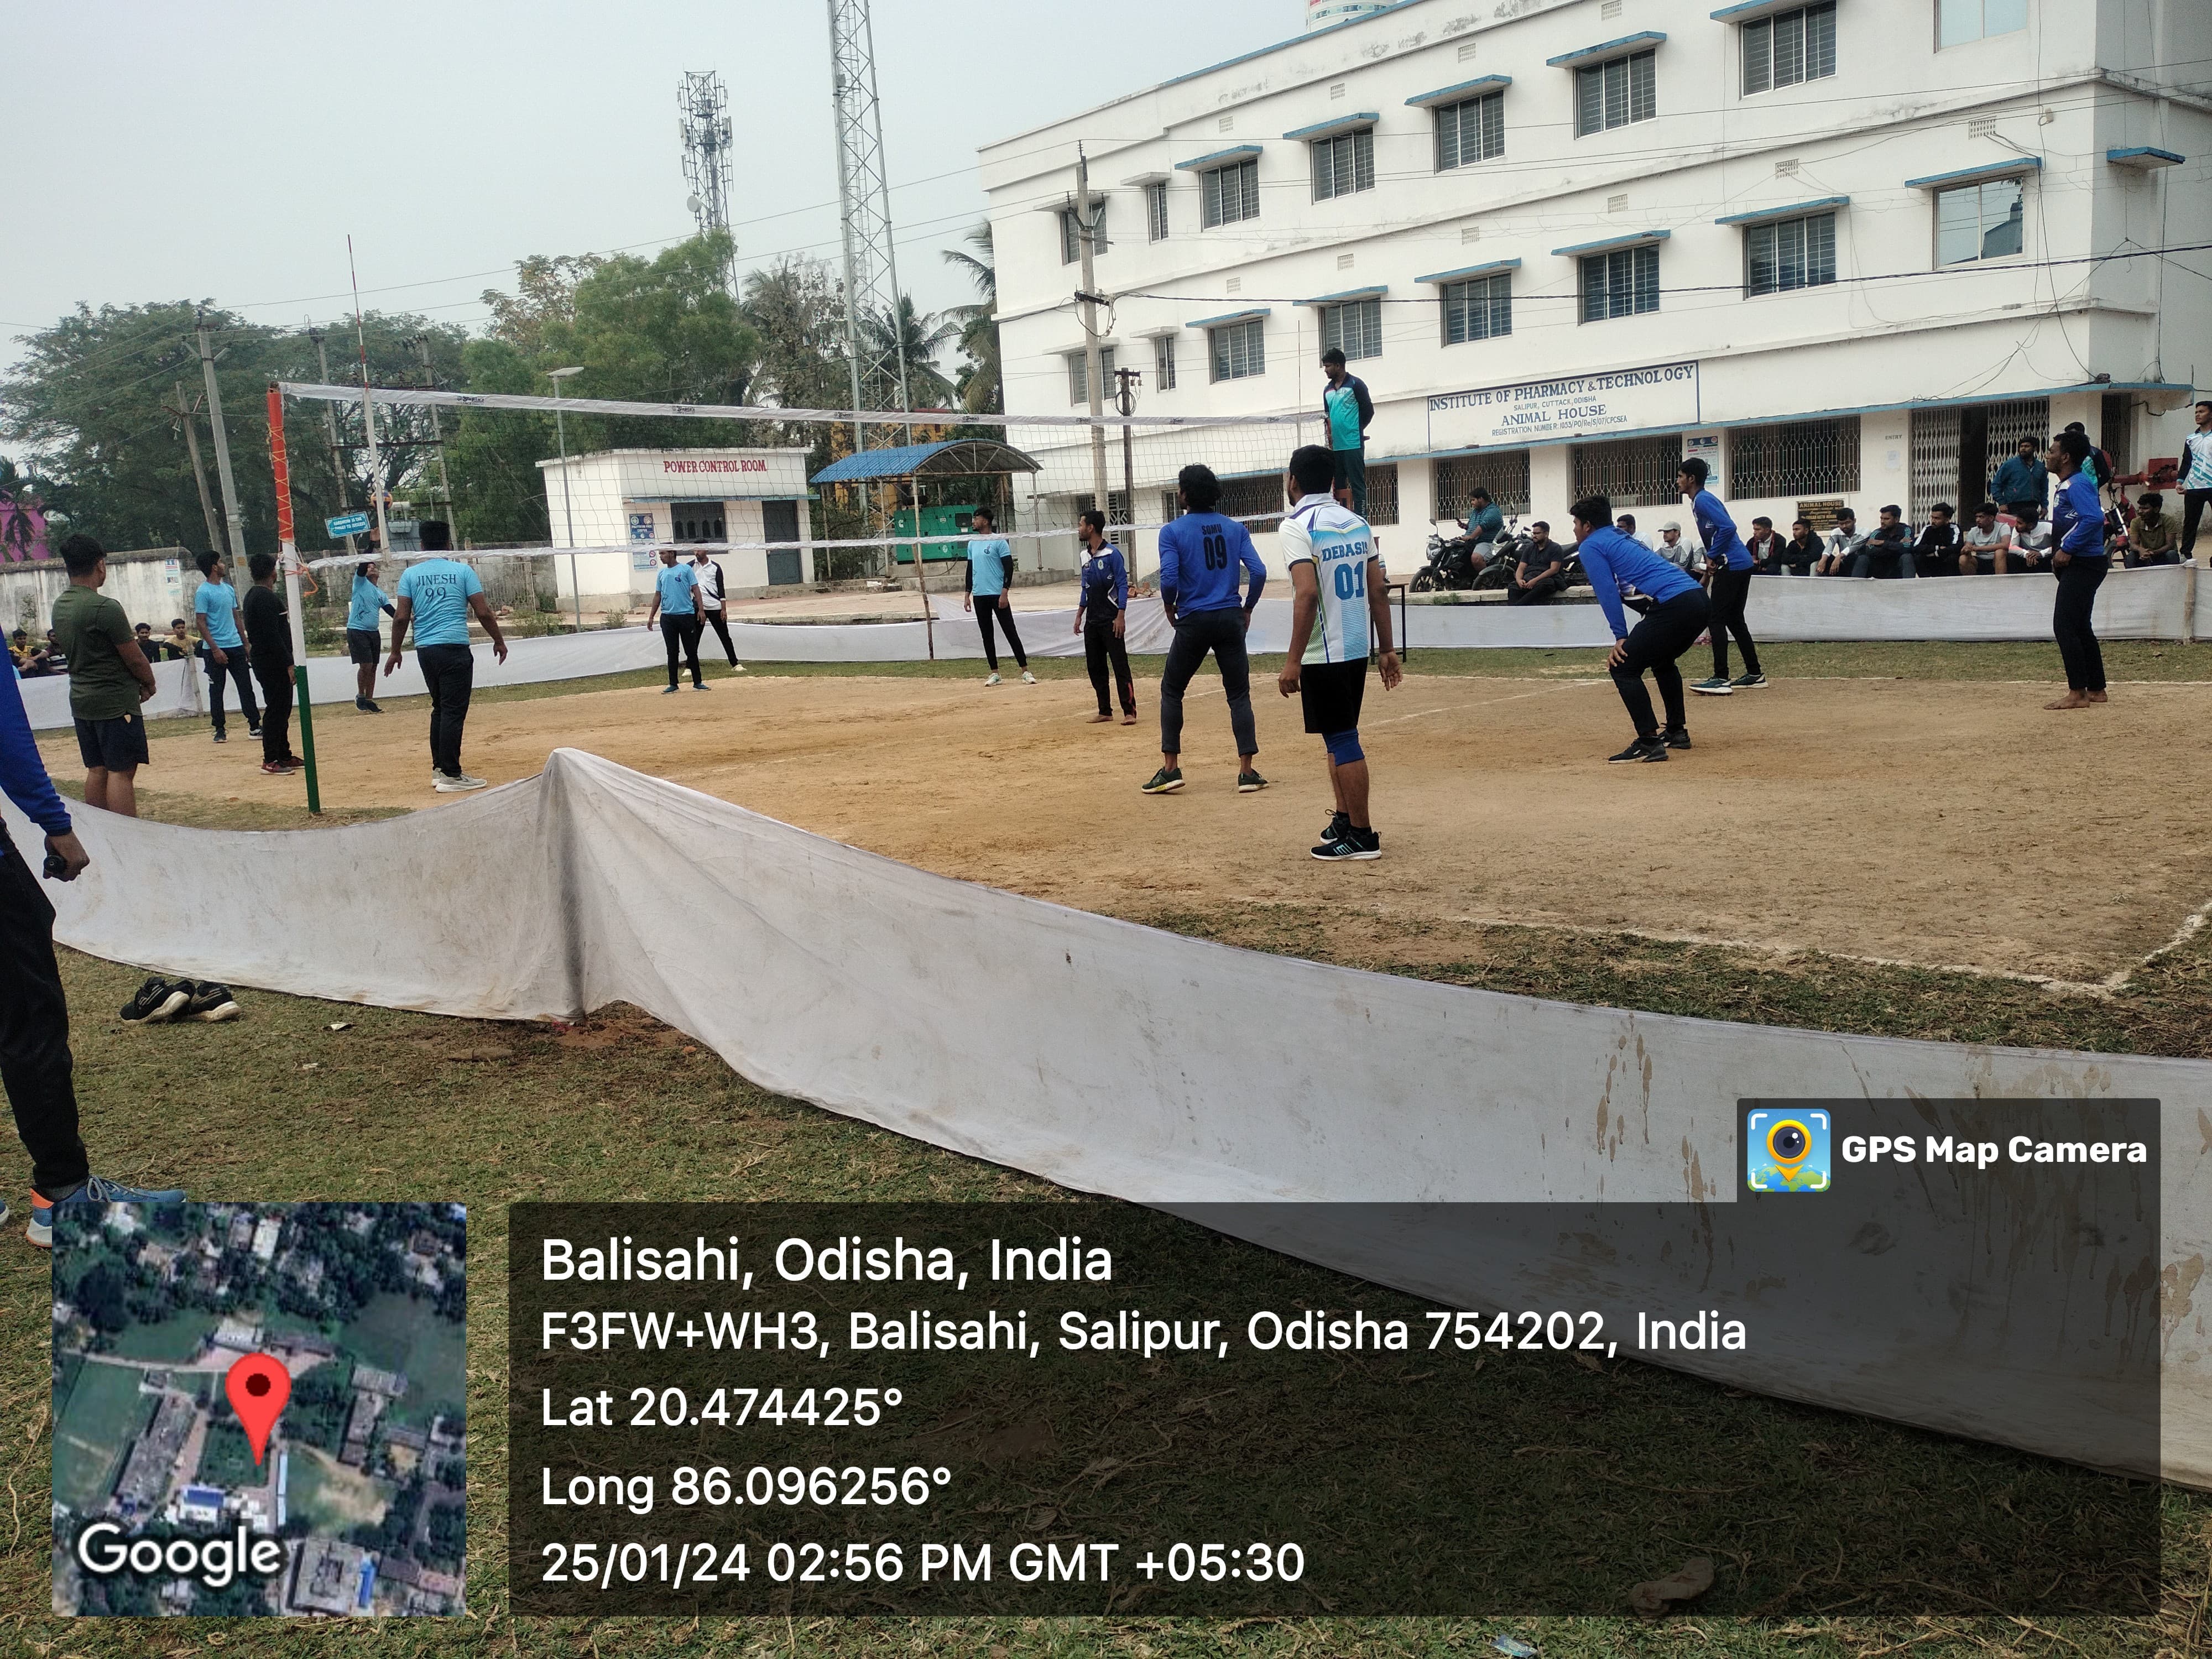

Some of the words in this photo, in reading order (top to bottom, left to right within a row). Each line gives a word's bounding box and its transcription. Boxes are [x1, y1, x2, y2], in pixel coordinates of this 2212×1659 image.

[1430, 392, 1492, 411] INSTITUTE
[1496, 390, 1511, 403] OF
[1514, 380, 1585, 401] PHARMACY
[1501, 411, 1551, 426] ANIMAL
[1558, 404, 1606, 420] HOUSE
[1492, 426, 1532, 436] REGISTRATION
[663, 460, 698, 473] POWER
[699, 460, 739, 473] CONTROL
[740, 460, 767, 472] ROOM
[1202, 524, 1222, 535] SOMU
[1203, 535, 1227, 571] 09
[417, 574, 456, 586] JINESH
[1334, 561, 1364, 600] 01
[425, 587, 447, 602] 99
